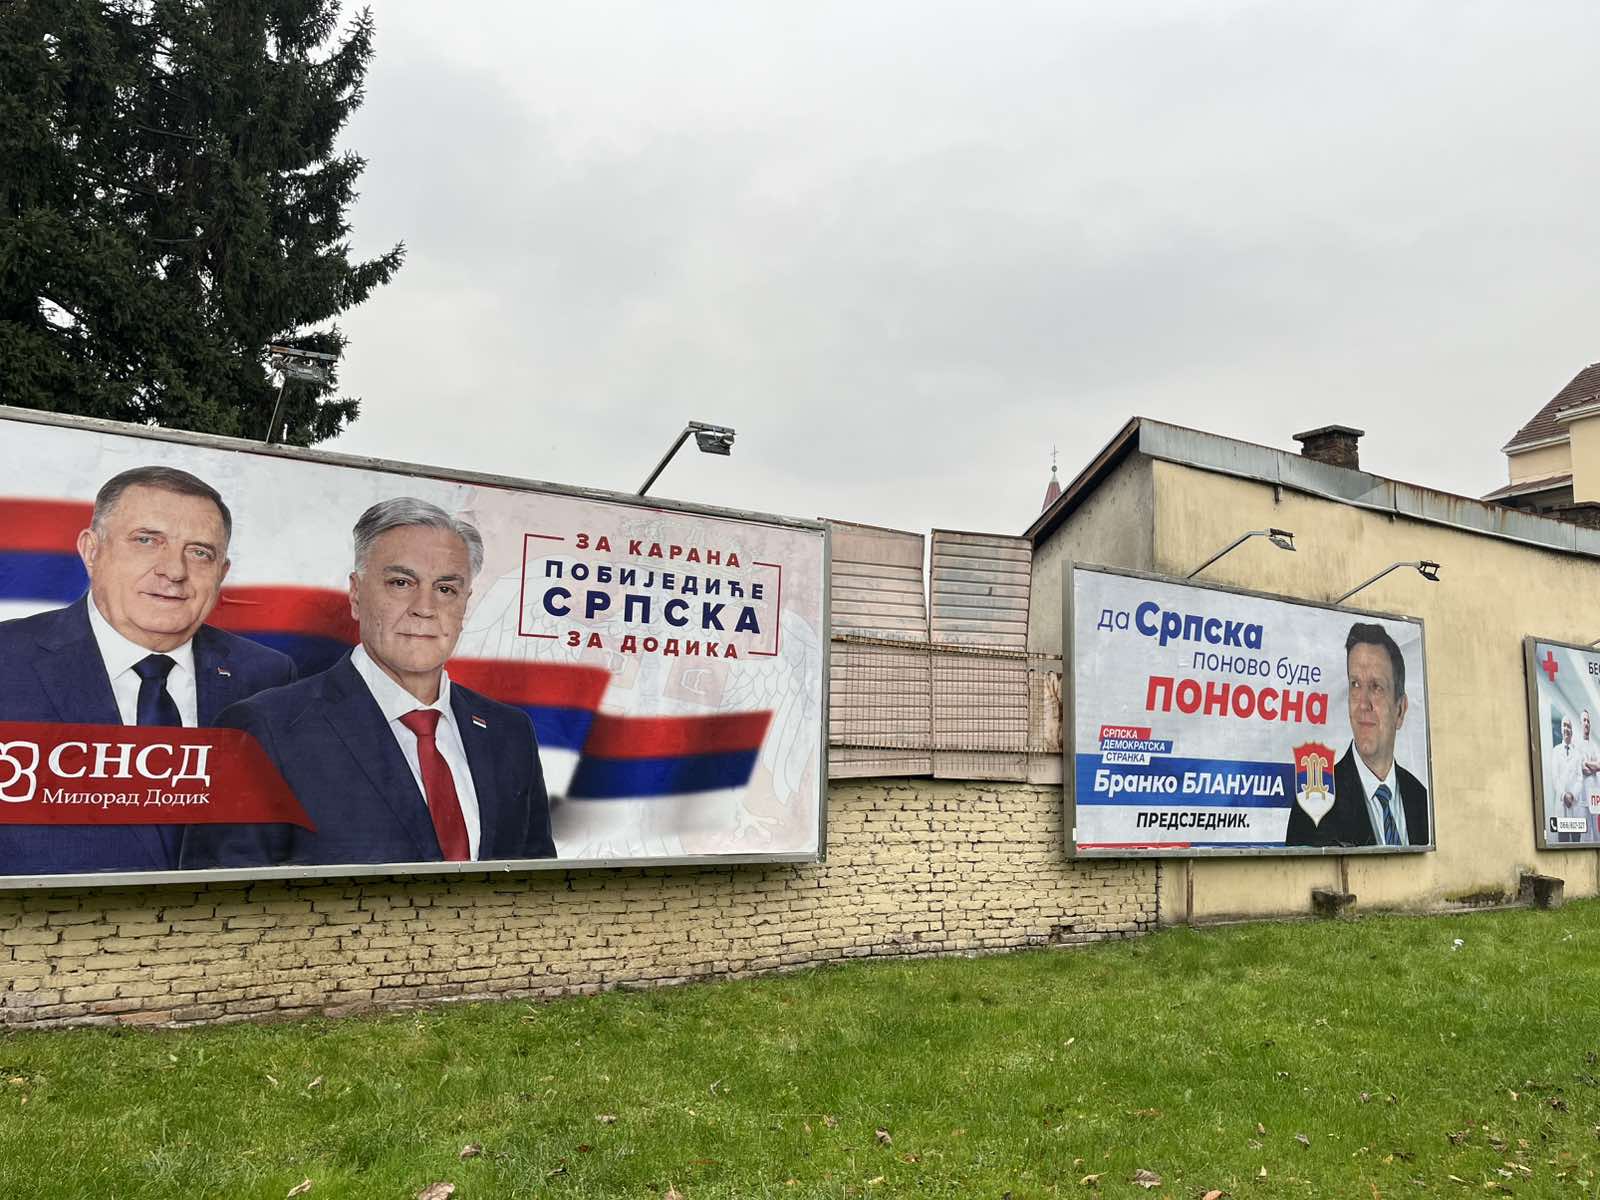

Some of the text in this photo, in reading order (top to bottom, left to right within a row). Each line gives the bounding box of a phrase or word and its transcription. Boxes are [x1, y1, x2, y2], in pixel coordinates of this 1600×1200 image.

[575, 533, 740, 568] ЗА КАРАНА
[545, 559, 764, 600] ПОБИЈЕДИЋЕ
[543, 586, 761, 634] СРПСКА
[1097, 601, 1264, 650] да Српска
[567, 631, 738, 659] ЗА ДОДИКА
[1192, 652, 1321, 685] поново буде
[1588, 662, 1600, 675] БЕ
[1102, 739, 1165, 751] ДЕМОКРАТСКА
[1103, 728, 1138, 739] СРПСКА
[48, 741, 213, 787] СНСД
[1106, 752, 1145, 762] СТРАНКА
[1094, 769, 1285, 798] Бранко БЛАНУША
[41, 788, 210, 808] Милорад Додик
[1136, 812, 1250, 831] ПРЕДСЈЕДНИК.
